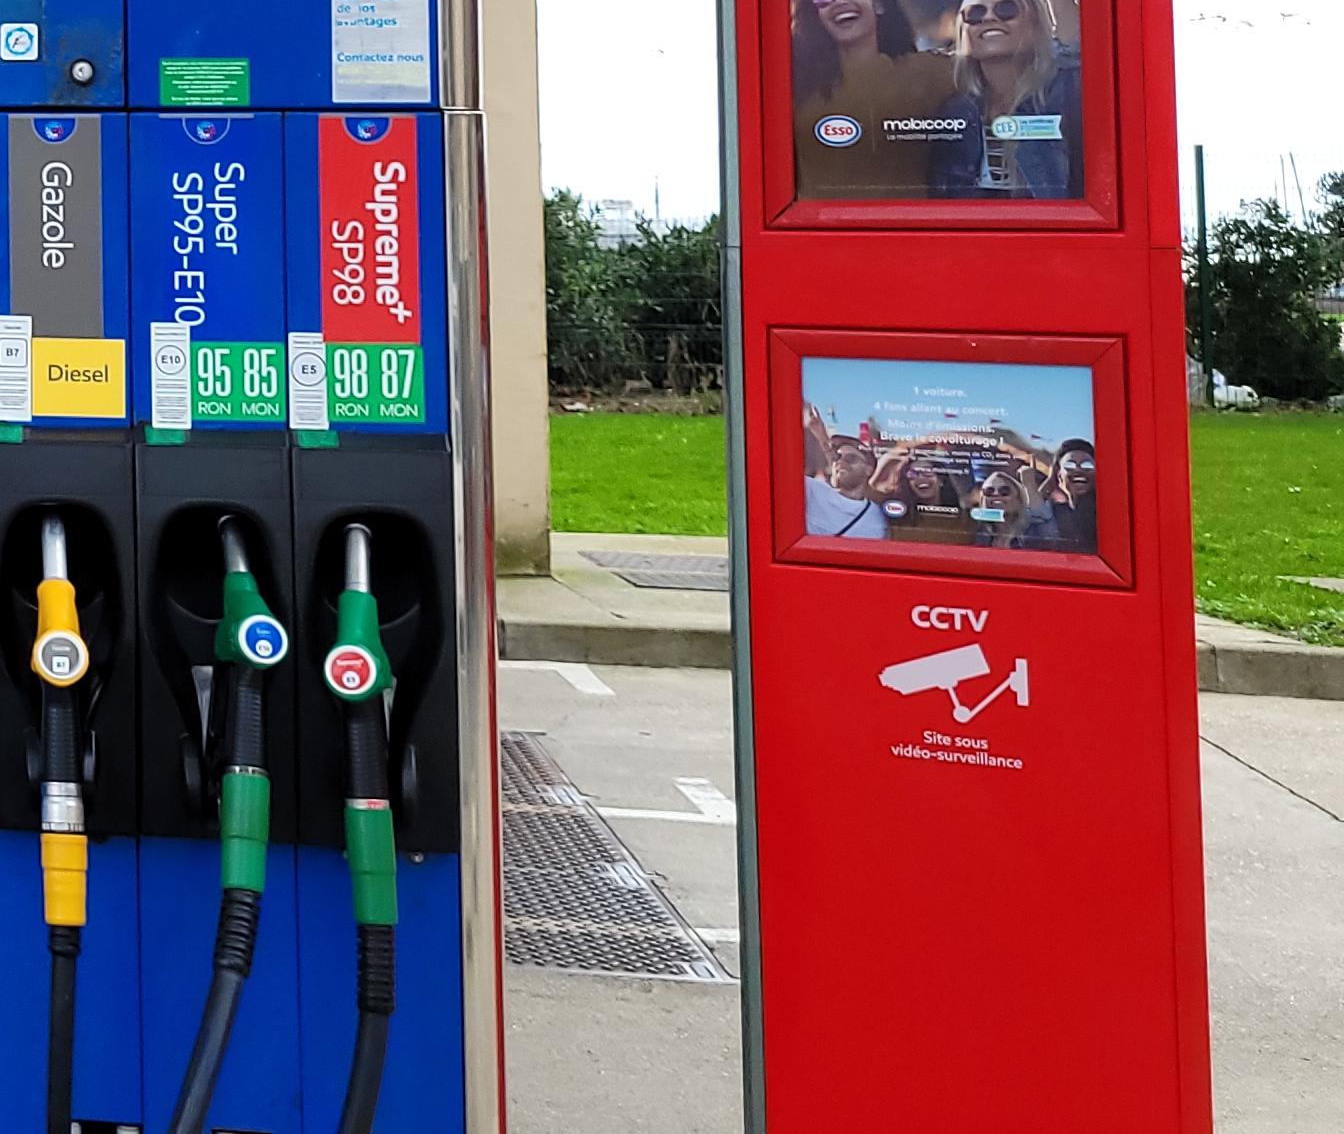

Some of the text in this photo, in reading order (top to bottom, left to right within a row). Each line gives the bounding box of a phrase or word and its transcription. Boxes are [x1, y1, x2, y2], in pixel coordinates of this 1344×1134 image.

[337, 4, 351, 13] de
[337, 52, 424, 63] Contactez nous
[824, 124, 854, 136] Esso
[883, 118, 966, 131] mobicoop
[40, 161, 75, 269] Gazole
[205, 162, 246, 255] Super
[172, 172, 205, 327] SP95-E10
[365, 160, 412, 324] Supreme+
[331, 219, 365, 306] SP98
[6, 347, 20, 357] B7
[161, 354, 181, 364] E10
[48, 364, 109, 383] Diesel
[197, 347, 278, 398] 95 85
[301, 364, 317, 375] E5
[333, 348, 415, 399] 98 87
[914, 386, 967, 397] 1 voiture.
[197, 402, 232, 415] RON
[241, 402, 280, 416] MON
[335, 403, 370, 417] RON
[379, 403, 419, 418] MON
[873, 401, 1009, 417] 4 fans allant au concert.
[887, 418, 922, 429] Moins
[880, 430, 997, 448] Bravo le covoiturage
[911, 605, 989, 633] CCTV
[923, 730, 989, 749] Site sous
[891, 743, 1023, 769] vidéo-surveillance
